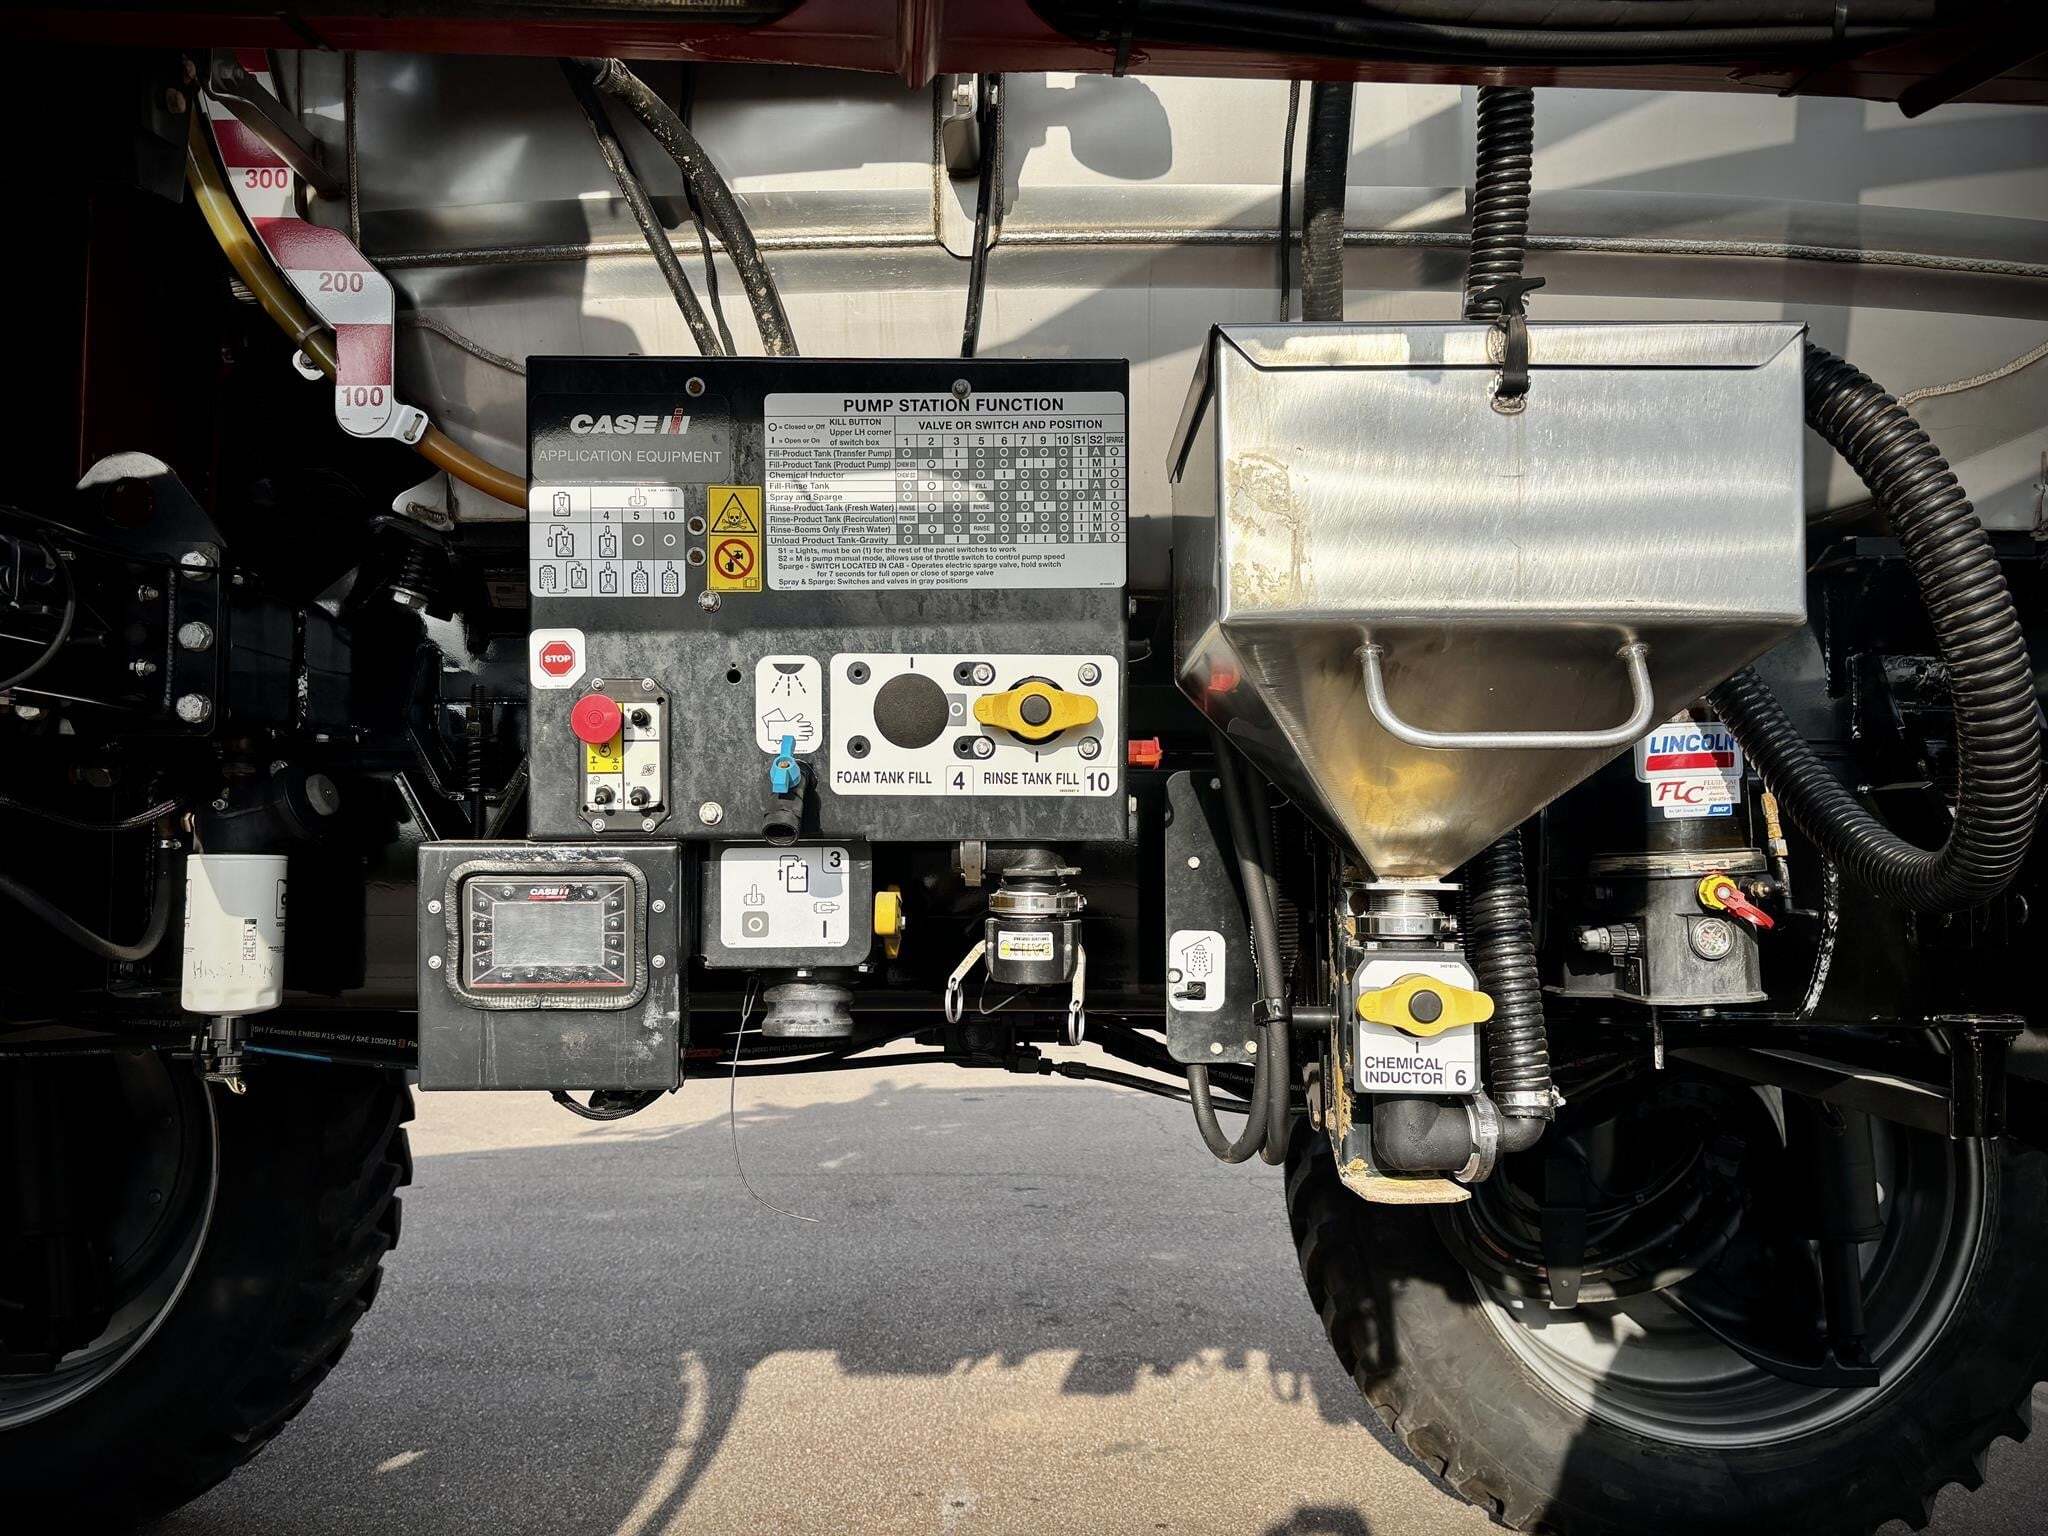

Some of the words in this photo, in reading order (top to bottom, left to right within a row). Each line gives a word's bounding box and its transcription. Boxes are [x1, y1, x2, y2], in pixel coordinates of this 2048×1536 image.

[244, 169, 288, 189] 300
[319, 272, 364, 293] 200
[341, 386, 384, 407] 100
[844, 399, 894, 412] PUMP
[899, 398, 970, 412] STATION
[976, 397, 1064, 411] FUNCTION
[570, 414, 659, 435] CASE
[829, 418, 847, 426] KILL
[848, 418, 882, 426] BUTTON
[918, 421, 953, 430] VALVE
[955, 421, 972, 430] OR
[975, 421, 1019, 430] SWITCH
[1022, 420, 1046, 429] AND
[1049, 420, 1103, 429] POSITION
[829, 429, 853, 437] Upper
[854, 428, 866, 436] LH
[784, 438, 801, 446] Open
[904, 438, 909, 446] 1
[928, 438, 935, 446] 2
[953, 437, 960, 446] 3
[978, 437, 985, 445] 5
[1001, 437, 1007, 445] 6
[1021, 436, 1027, 445] 7
[1040, 436, 1047, 445] 9
[1057, 436, 1069, 445] 10
[1073, 436, 1086, 444] S1
[1089, 436, 1103, 444] S2
[537, 450, 634, 462] APPLICATION
[637, 451, 722, 463] EQUIPMENT
[768, 450, 812, 460] Fill-Product
[813, 450, 832, 460] Tank
[833, 450, 866, 460] (Transfer
[868, 450, 892, 460] Pump)
[769, 461, 813, 471] Fill-Product
[813, 461, 832, 471] Tank
[833, 461, 866, 470] (Product
[867, 461, 891, 470] Pump)
[769, 472, 808, 480] Chemical
[810, 471, 845, 480] Inductor
[769, 482, 808, 490] Fill-Rinse
[810, 482, 830, 490] Tank
[769, 493, 793, 502] Spray
[795, 493, 811, 501] and
[813, 493, 843, 502] Sparge
[825, 504, 843, 512] Tank
[844, 504, 869, 512] (Fresh
[870, 504, 895, 512] Water)
[603, 511, 610, 521] 4
[633, 511, 640, 521] 5
[662, 510, 675, 521] 10
[770, 516, 823, 525] Rinse-Product
[824, 515, 842, 523] Tank
[843, 515, 895, 524] (Recirculation)
[822, 526, 840, 535] Only
[841, 526, 865, 535] (Fresh
[866, 526, 891, 535] Water)
[770, 537, 800, 546] Unload
[802, 537, 835, 546] Product
[836, 537, 889, 546] Tank-Gravity
[862, 547, 872, 555] (1)
[778, 563, 804, 571] Sparge
[544, 654, 572, 663] STOP
[1650, 733, 1734, 754] LINCOLN
[837, 771, 870, 783] FOAM
[874, 771, 905, 784] TANK
[908, 772, 932, 784] FILL
[952, 771, 966, 790] 4
[984, 772, 1019, 785] RINSE
[1021, 772, 1052, 785] TANK
[1056, 773, 1080, 785] FILL
[1086, 772, 1110, 791] 10
[829, 851, 842, 868] 3
[529, 888, 559, 896] CASE
[1365, 1056, 1443, 1070] CHEMICAL
[1365, 1071, 1443, 1085] INDUCTOR
[1454, 1070, 1467, 1086] 6
